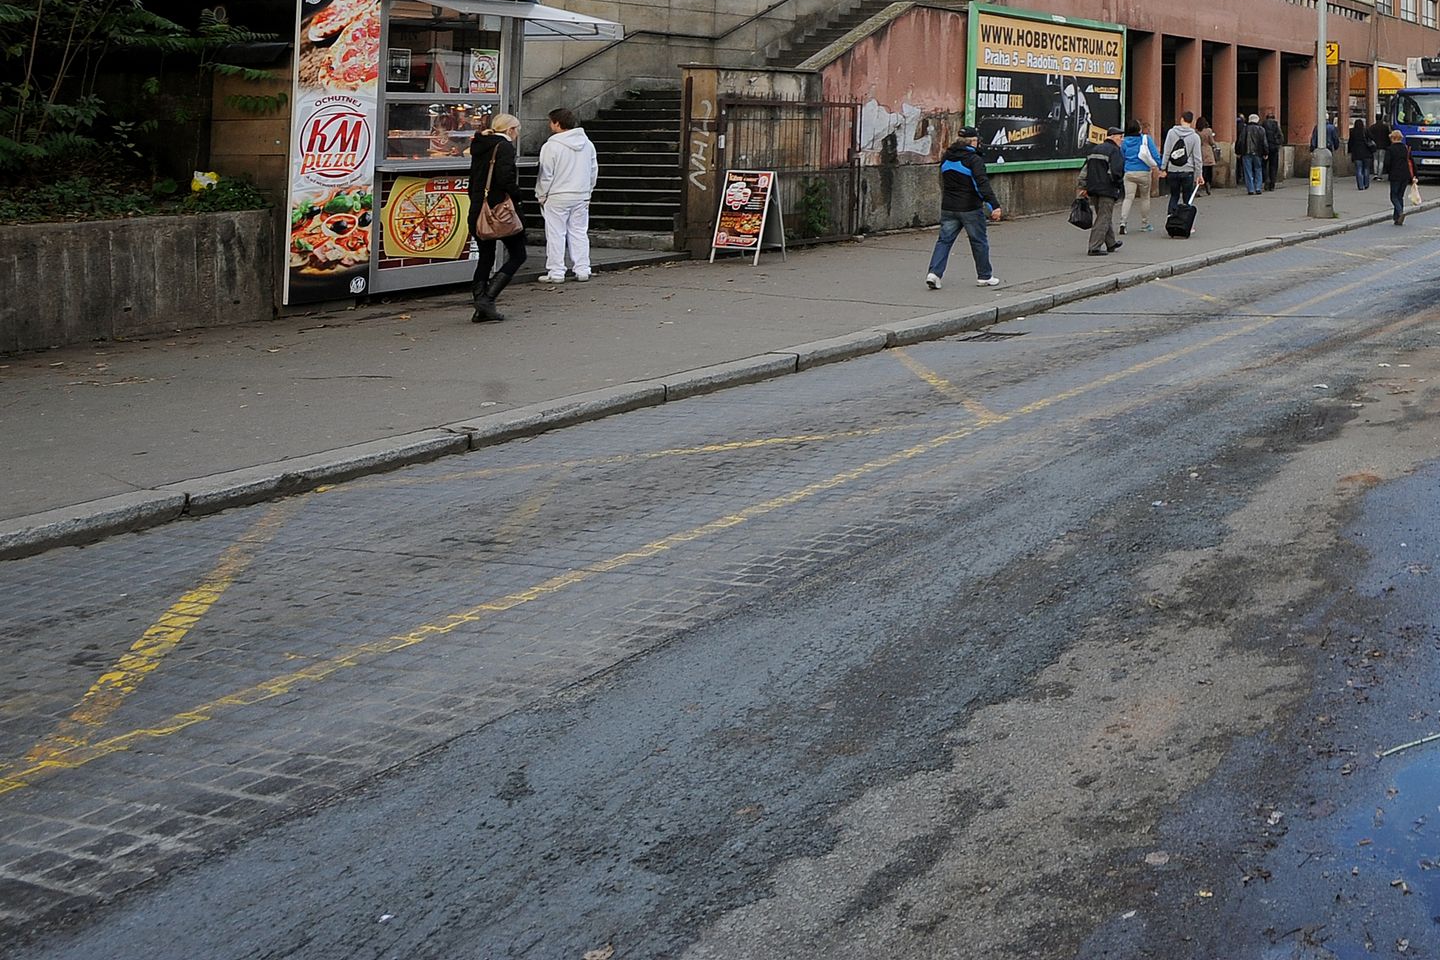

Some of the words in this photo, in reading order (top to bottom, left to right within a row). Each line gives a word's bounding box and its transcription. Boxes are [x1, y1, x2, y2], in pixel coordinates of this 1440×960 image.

[980, 24, 1118, 57] WWW.HOBBYCENTRUM.CZ
[984, 47, 1010, 66] Praha
[1012, 51, 1019, 67] 5
[1074, 57, 1087, 73] 257
[1088, 58, 1101, 73] 911
[1103, 60, 1116, 74] 102
[306, 112, 367, 153] KM
[454, 178, 470, 190] 25
